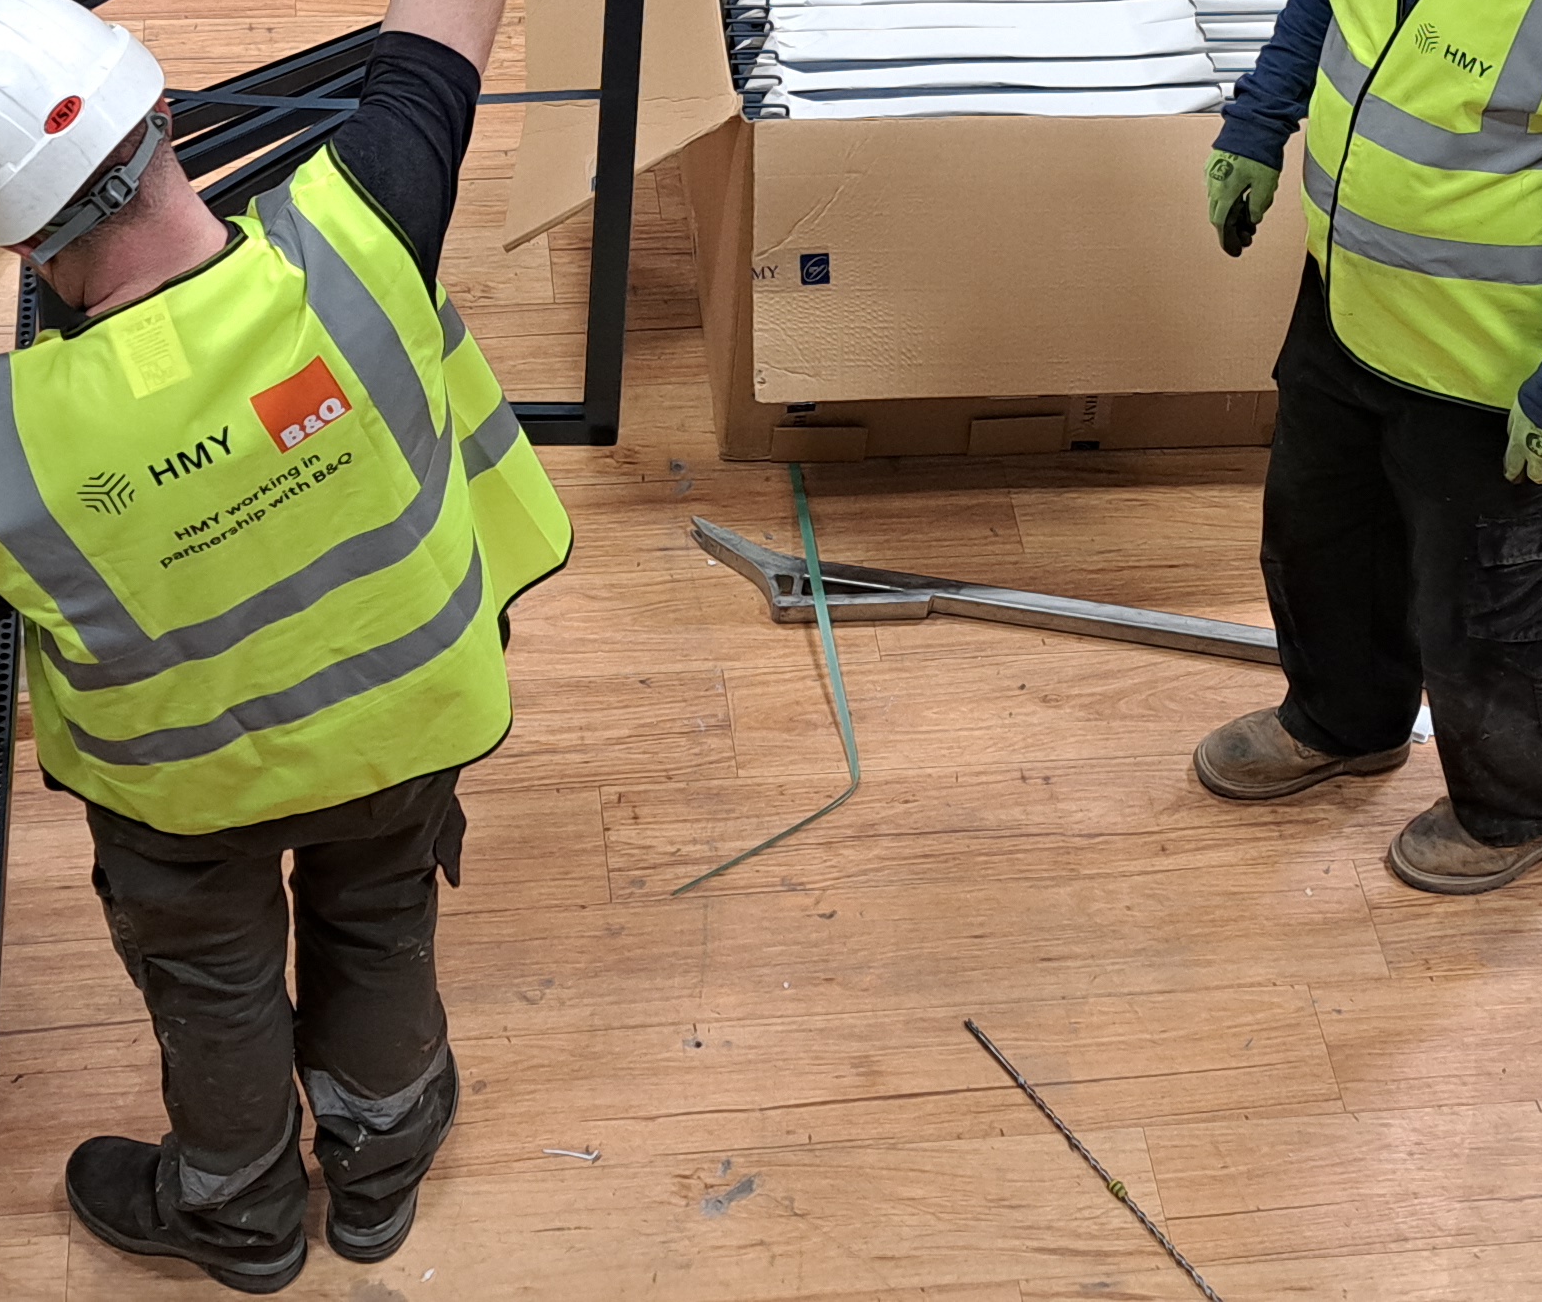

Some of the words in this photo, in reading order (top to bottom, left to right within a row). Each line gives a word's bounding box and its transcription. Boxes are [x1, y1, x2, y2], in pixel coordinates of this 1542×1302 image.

[1444, 44, 1493, 78] HMY
[50, 99, 76, 130] JSP
[751, 265, 779, 280] MY
[279, 397, 346, 449] B&Q
[147, 425, 232, 487] HMY
[159, 507, 266, 569] partnership
[268, 480, 311, 509] with
[312, 452, 353, 484] B&Q
[173, 512, 220, 541] HMY
[225, 465, 301, 516] working
[300, 454, 321, 470] in
